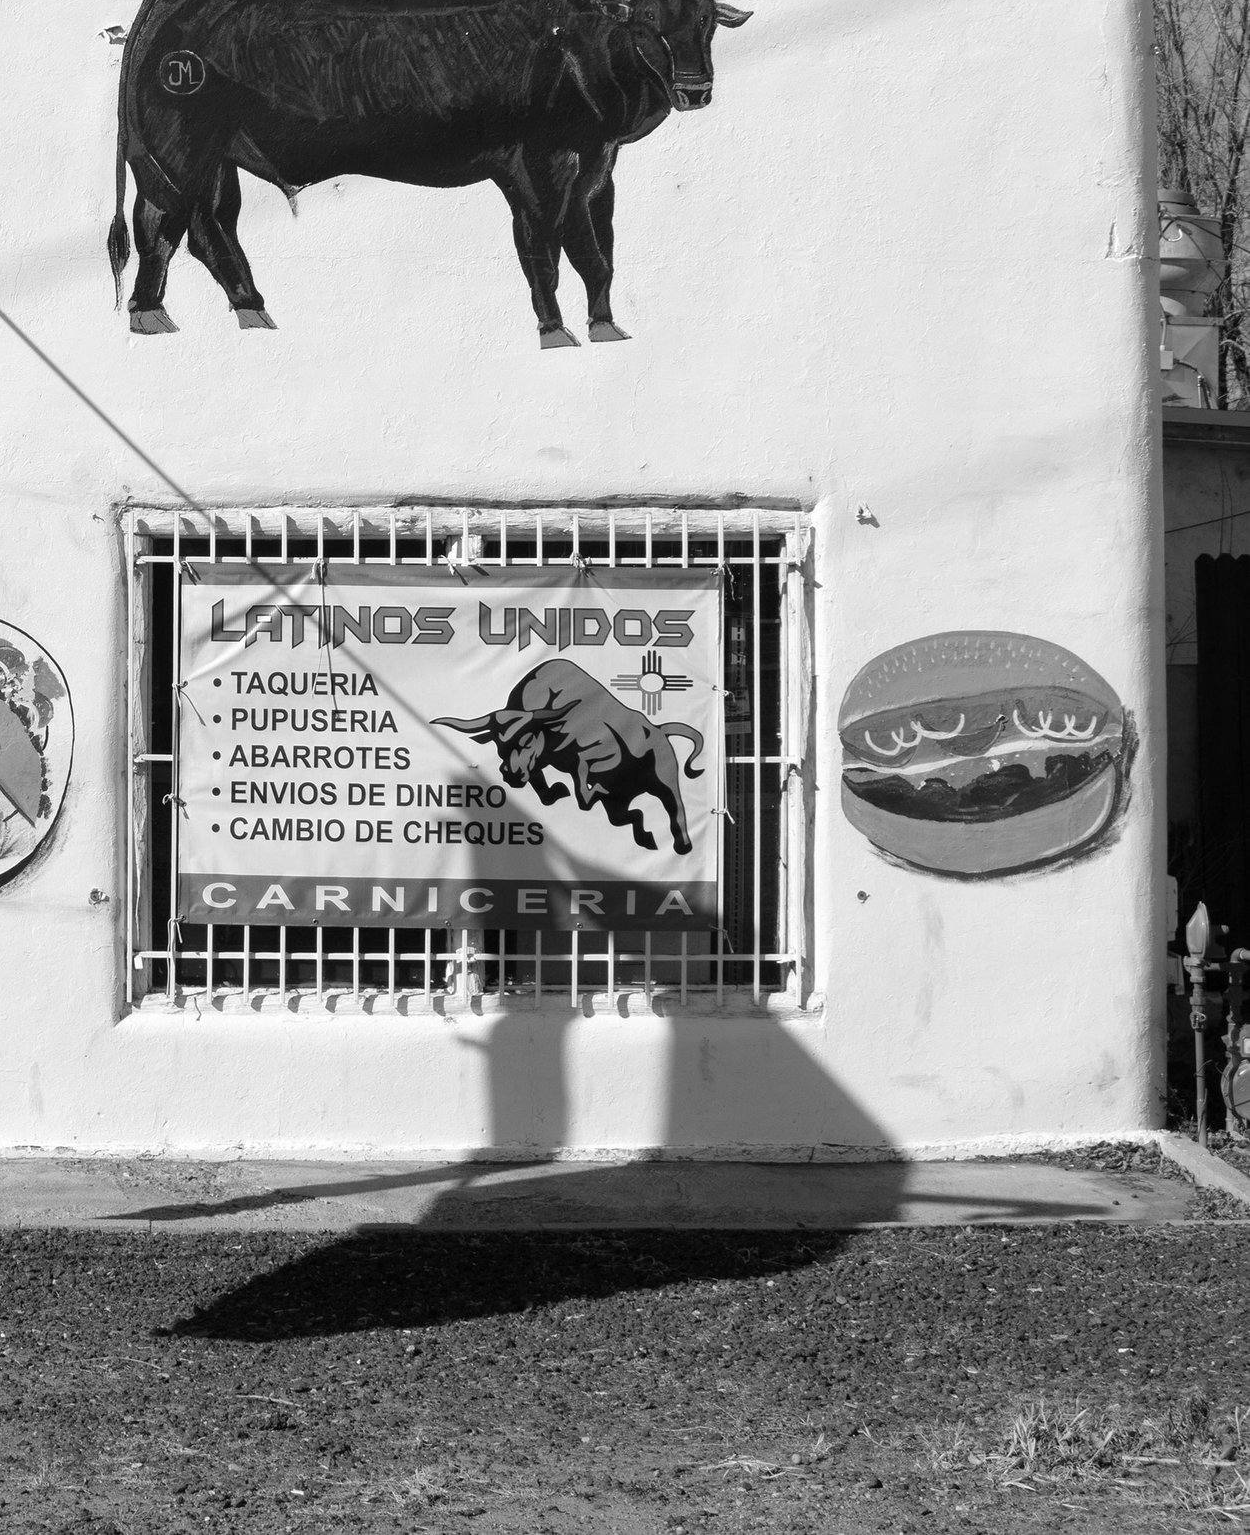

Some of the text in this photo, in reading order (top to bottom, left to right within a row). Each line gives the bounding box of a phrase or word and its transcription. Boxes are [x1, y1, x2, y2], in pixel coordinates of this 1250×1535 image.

[211, 599, 695, 651] LATINOS UNIDOS
[231, 672, 378, 697] TAQUERIA
[231, 709, 398, 733] PUPUSERIA
[229, 745, 410, 770] ABARROTES
[230, 781, 507, 809] ENVIOS DE DINERO
[229, 817, 545, 846] CAMBIO DE CHEQUES
[202, 883, 694, 915] CARNICERIA
